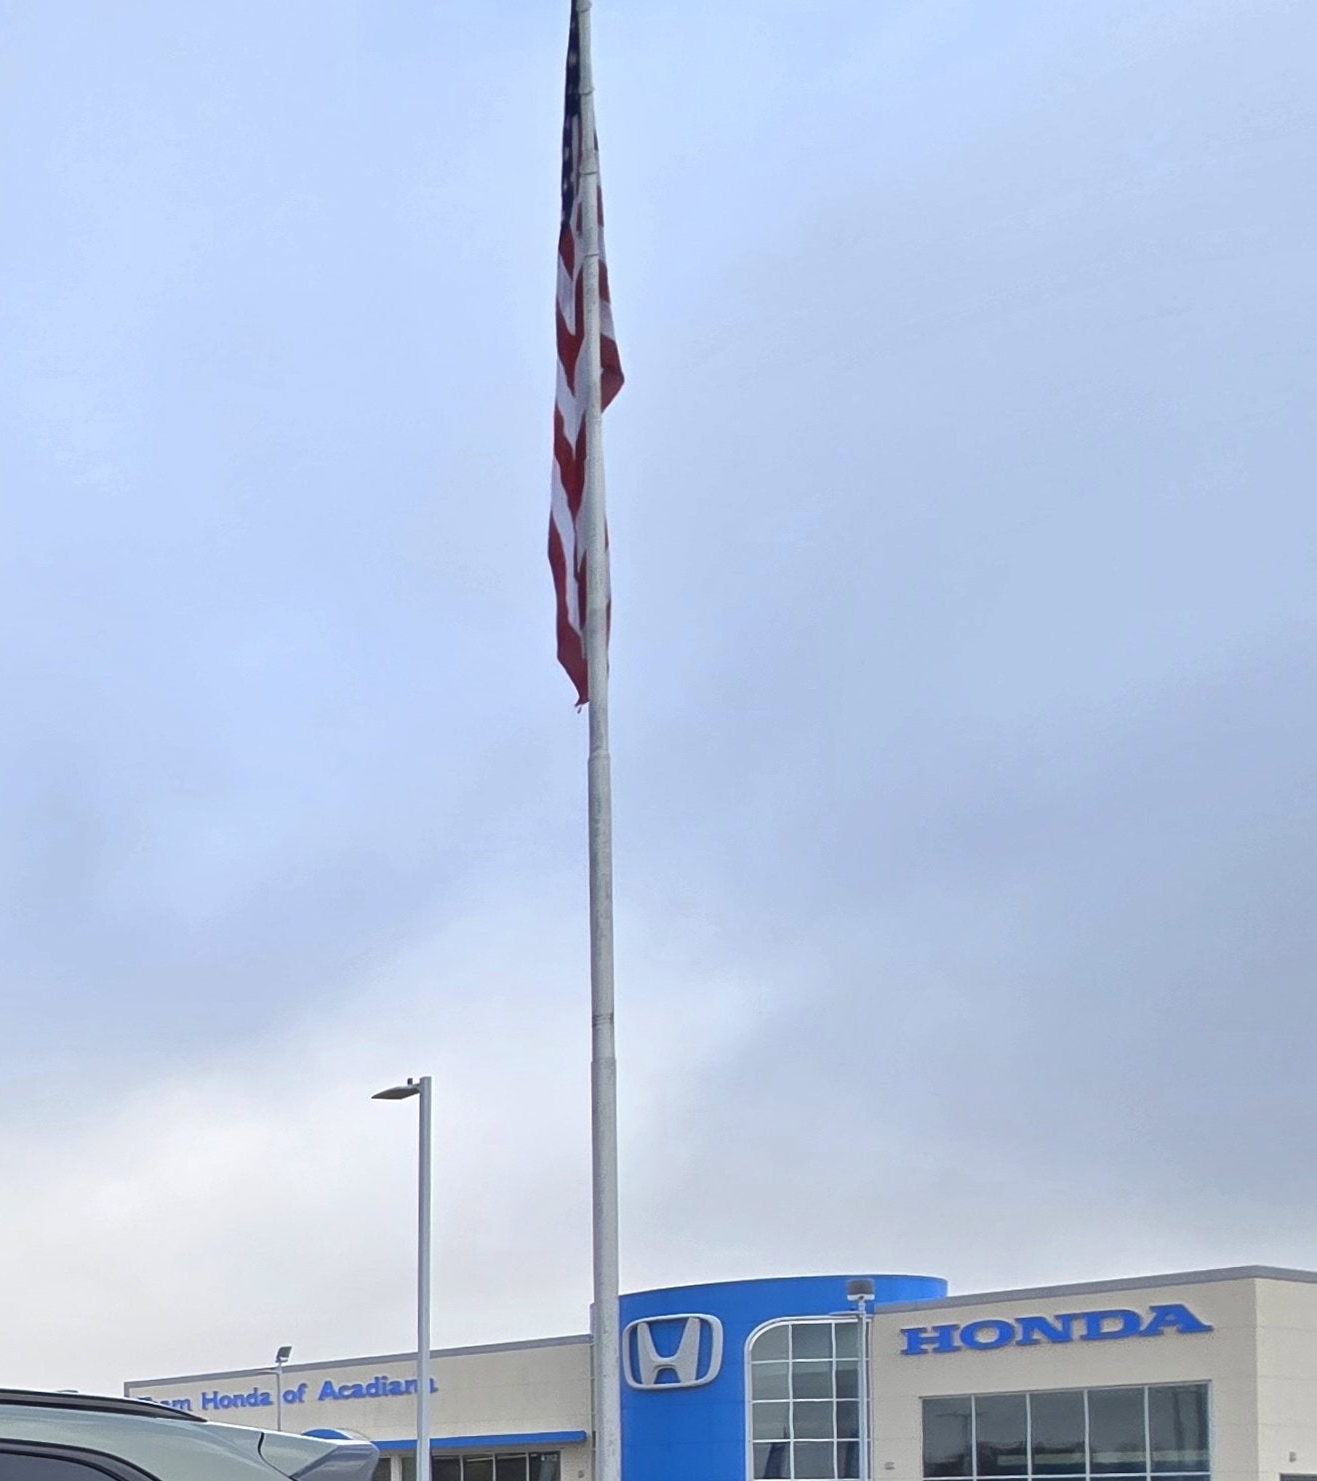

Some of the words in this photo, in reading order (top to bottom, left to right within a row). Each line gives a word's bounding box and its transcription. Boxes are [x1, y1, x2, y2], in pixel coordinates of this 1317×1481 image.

[900, 1304, 1214, 1356] HONDA
[201, 1387, 274, 1411] Honda
[282, 1383, 309, 1404] of
